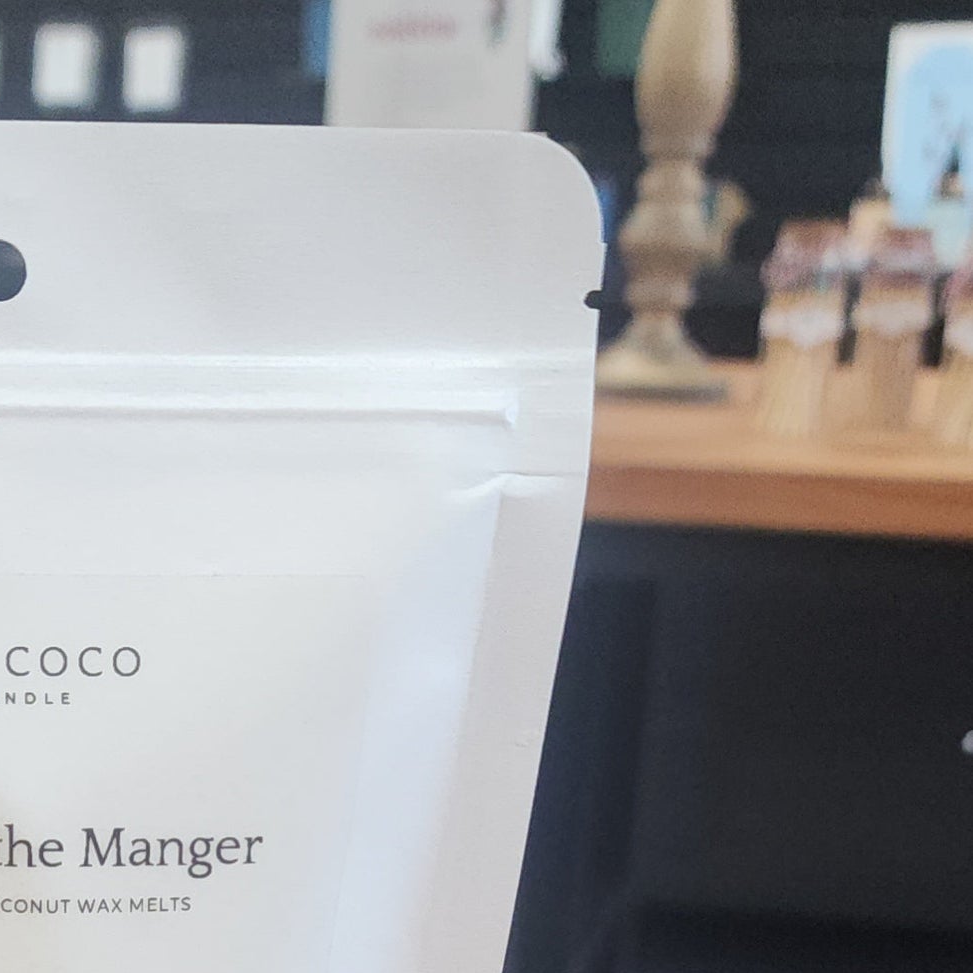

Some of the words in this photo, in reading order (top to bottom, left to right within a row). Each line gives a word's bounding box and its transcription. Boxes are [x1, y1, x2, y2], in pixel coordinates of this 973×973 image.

[5, 645, 141, 678] COCO
[78, 827, 264, 880] Manger
[76, 898, 123, 914] WAX
[129, 896, 192, 913] MELTS
